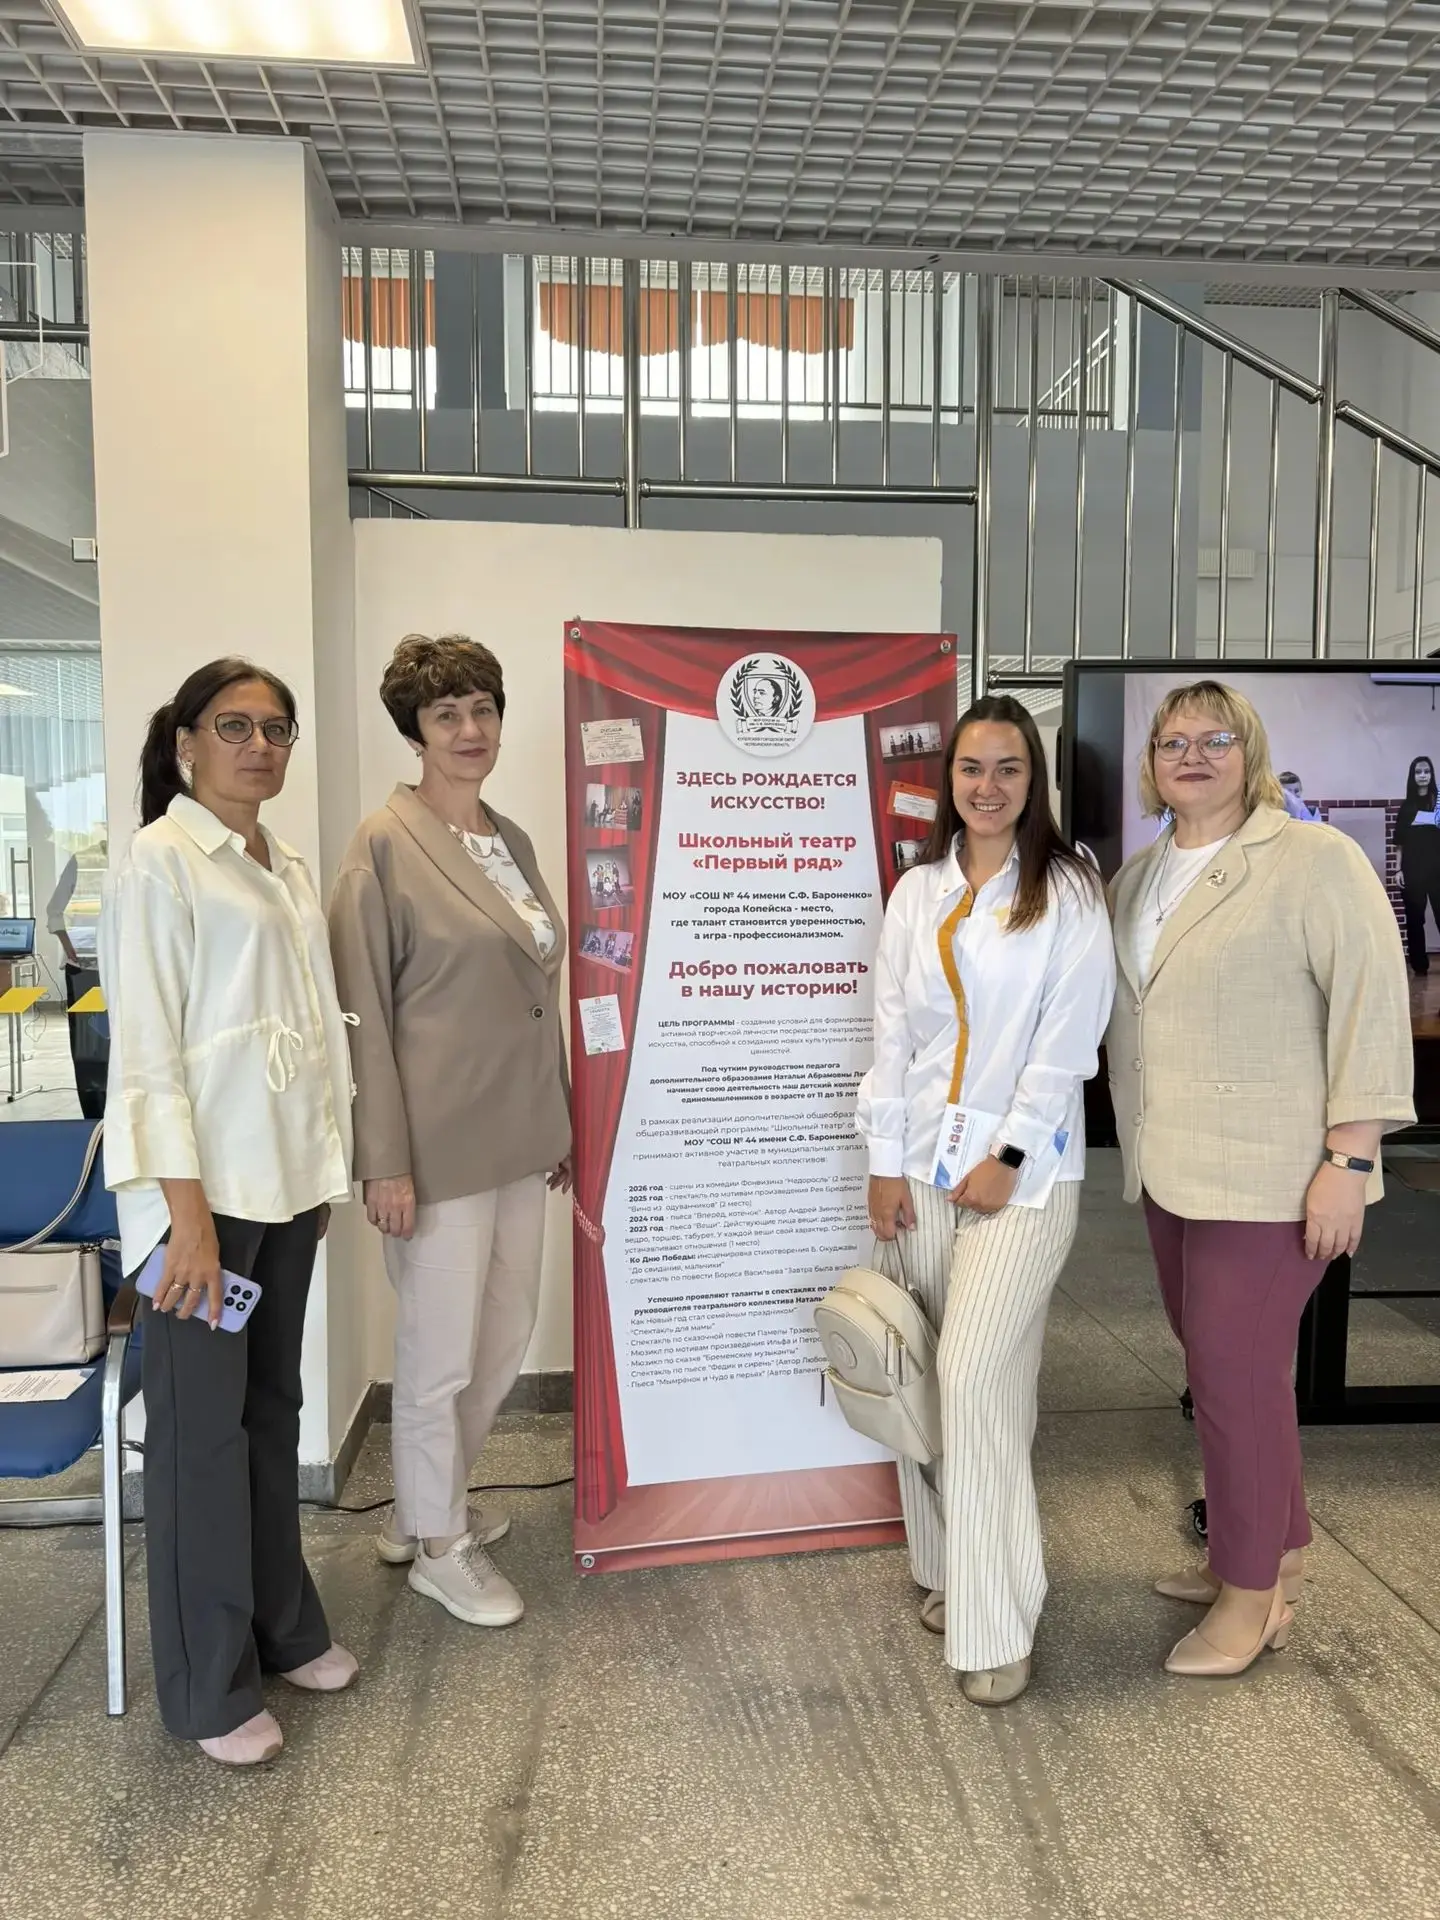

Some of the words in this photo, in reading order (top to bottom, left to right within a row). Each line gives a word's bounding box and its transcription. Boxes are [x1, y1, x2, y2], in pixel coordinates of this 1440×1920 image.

[677, 772, 736, 787] ЗДЕСЬ
[742, 773, 856, 788] РОЖДАЕТСЯ
[711, 796, 825, 809] ИСКУССТВО!
[678, 833, 793, 848] Школьный
[799, 836, 856, 851] театр
[693, 854, 787, 873] «Первый
[794, 858, 842, 873] ряд»
[663, 892, 687, 900] МОУ
[690, 892, 719, 900] «СОШ
[723, 891, 734, 899] №
[788, 892, 809, 900] С.Ф.
[812, 891, 872, 901] Бароненко»
[704, 906, 740, 914] города
[743, 905, 792, 914] Копейска
[801, 906, 833, 914] место,
[671, 920, 688, 928] где
[790, 918, 865, 927] уверенностью,
[669, 960, 737, 979] Добро
[744, 961, 868, 975] пожаловать
[682, 985, 692, 997] в
[700, 984, 755, 1000] нашу
[761, 980, 857, 998] историю!
[658, 1020, 680, 1029] ЦЕЛЬ
[682, 1018, 735, 1027] ПРОГРАММЫ
[684, 1138, 705, 1146] МОУ
[734, 1136, 744, 1144] №
[745, 1136, 757, 1144] 44
[789, 1134, 807, 1142] С.Ф.
[629, 1184, 648, 1192] 2026
[629, 1194, 648, 1202] 2025
[629, 1214, 648, 1222] 2024
[629, 1224, 648, 1232] 2023
[642, 1255, 660, 1264] Дню
[662, 1253, 696, 1262] Победы:
